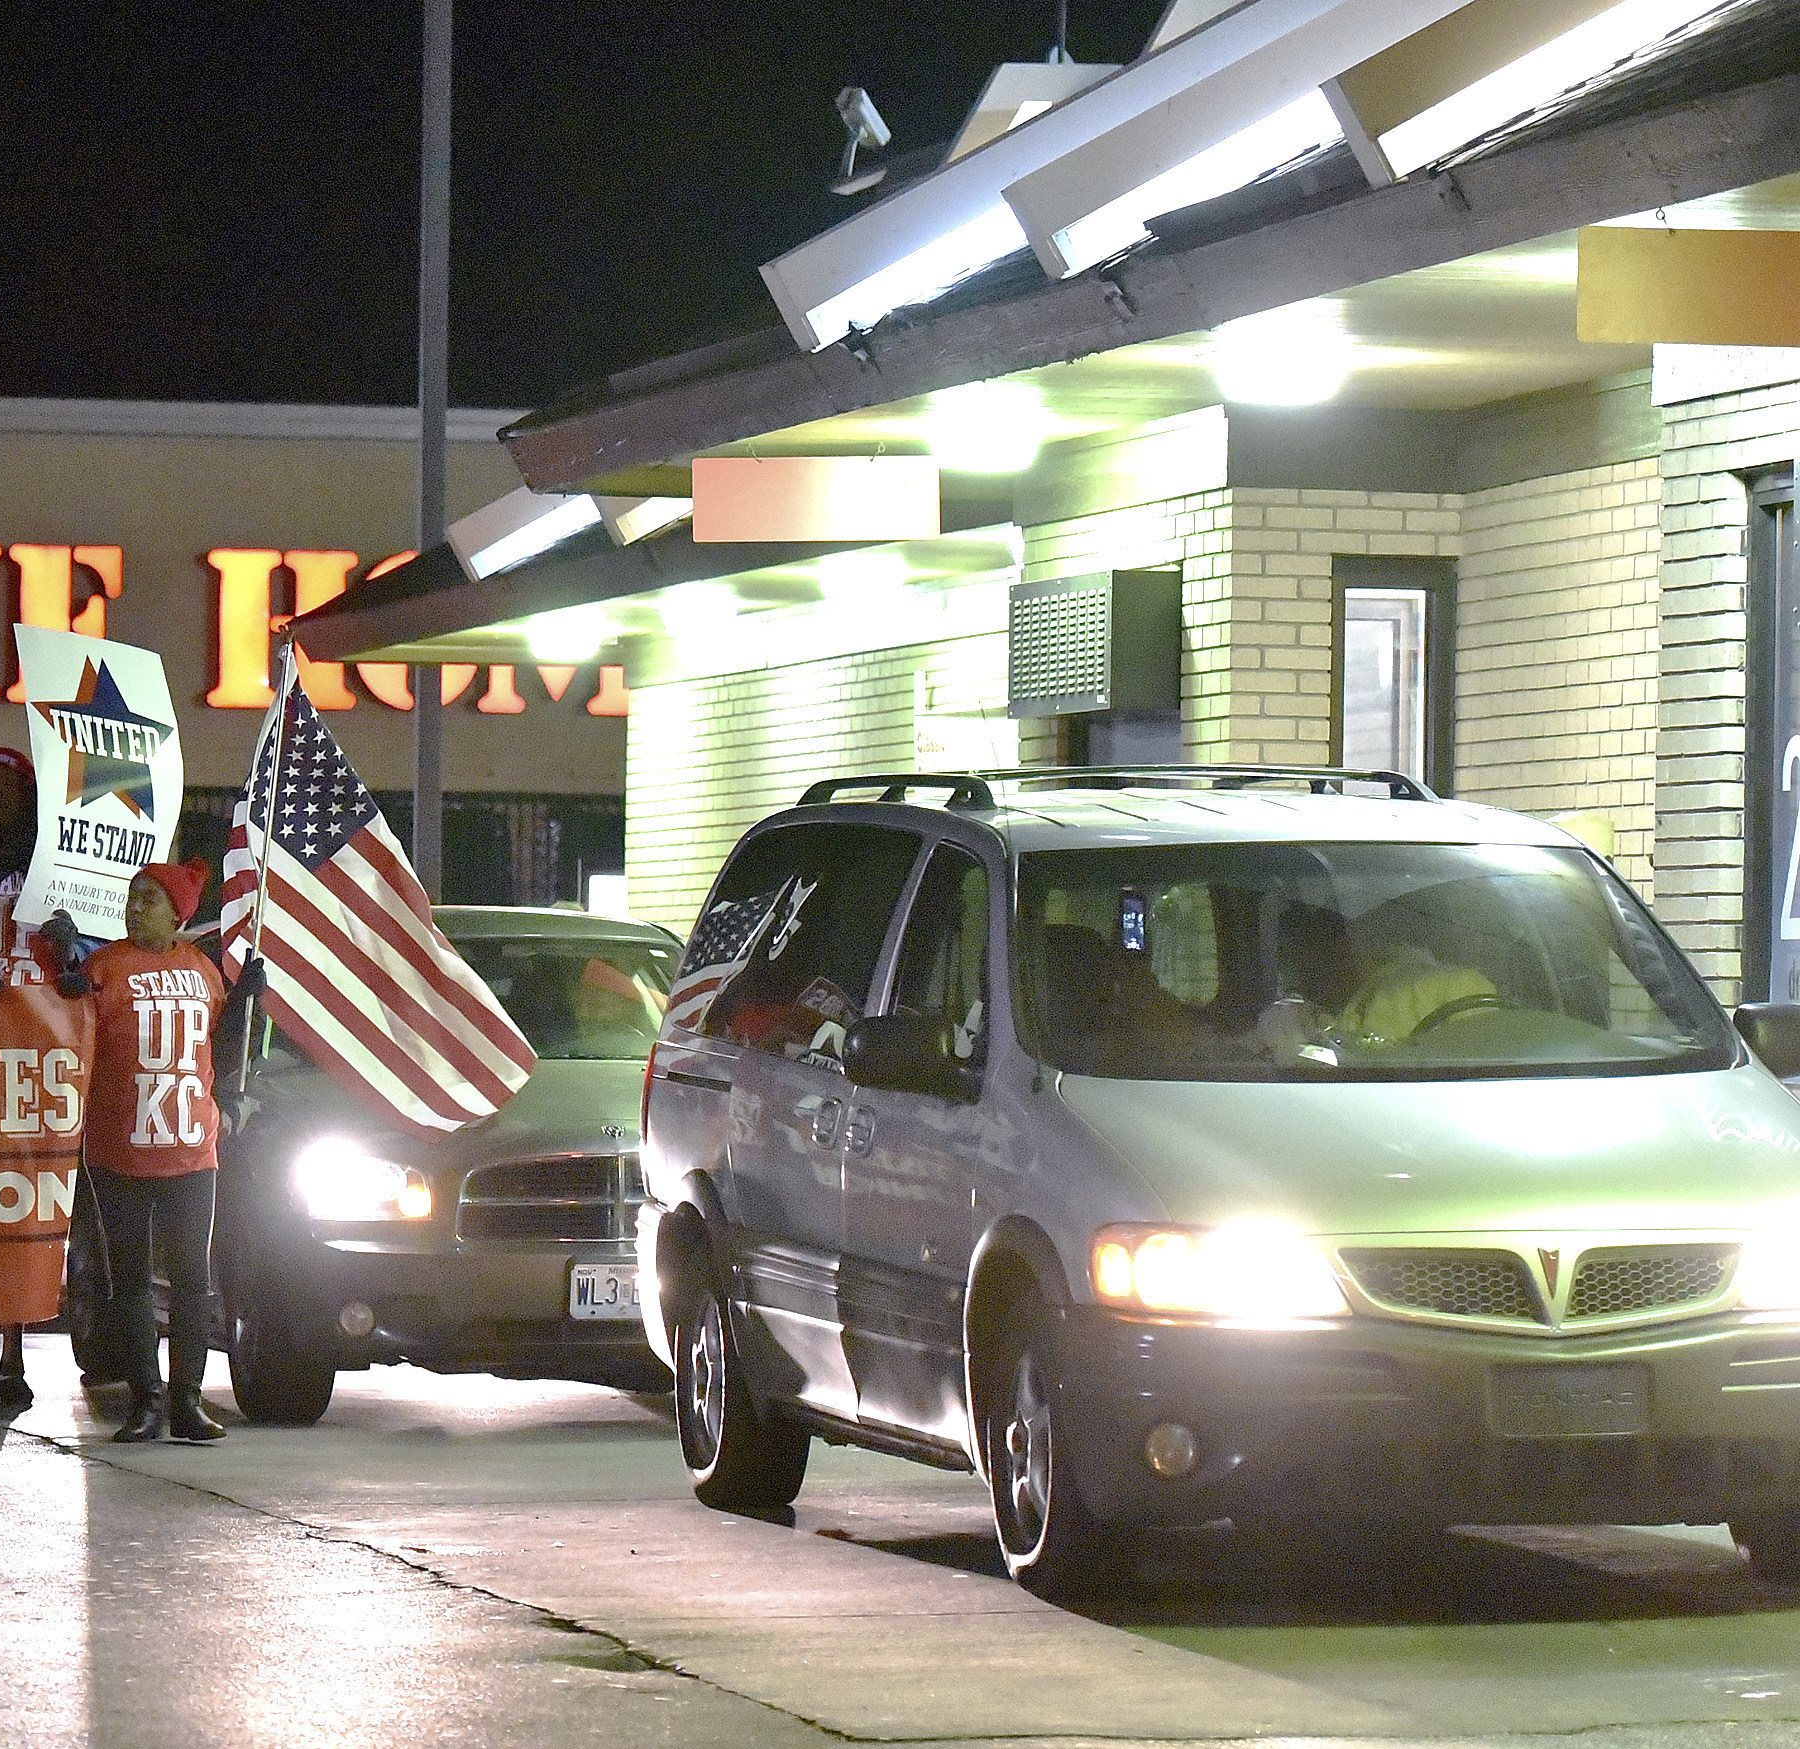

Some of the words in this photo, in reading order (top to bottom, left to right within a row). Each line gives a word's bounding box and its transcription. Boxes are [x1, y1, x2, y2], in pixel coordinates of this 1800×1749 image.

[50, 708, 162, 766] UNITED
[57, 815, 88, 855] WE
[92, 822, 157, 870] STAND
[44, 893, 56, 906] IS
[68, 899, 104, 915] INJURY
[104, 906, 115, 918] TO
[48, 879, 67, 892] AN
[68, 883, 104, 899] INJURY
[104, 889, 117, 902] TO
[128, 968, 211, 1002] STAND
[132, 999, 210, 1075] UP
[130, 1072, 206, 1148] KC
